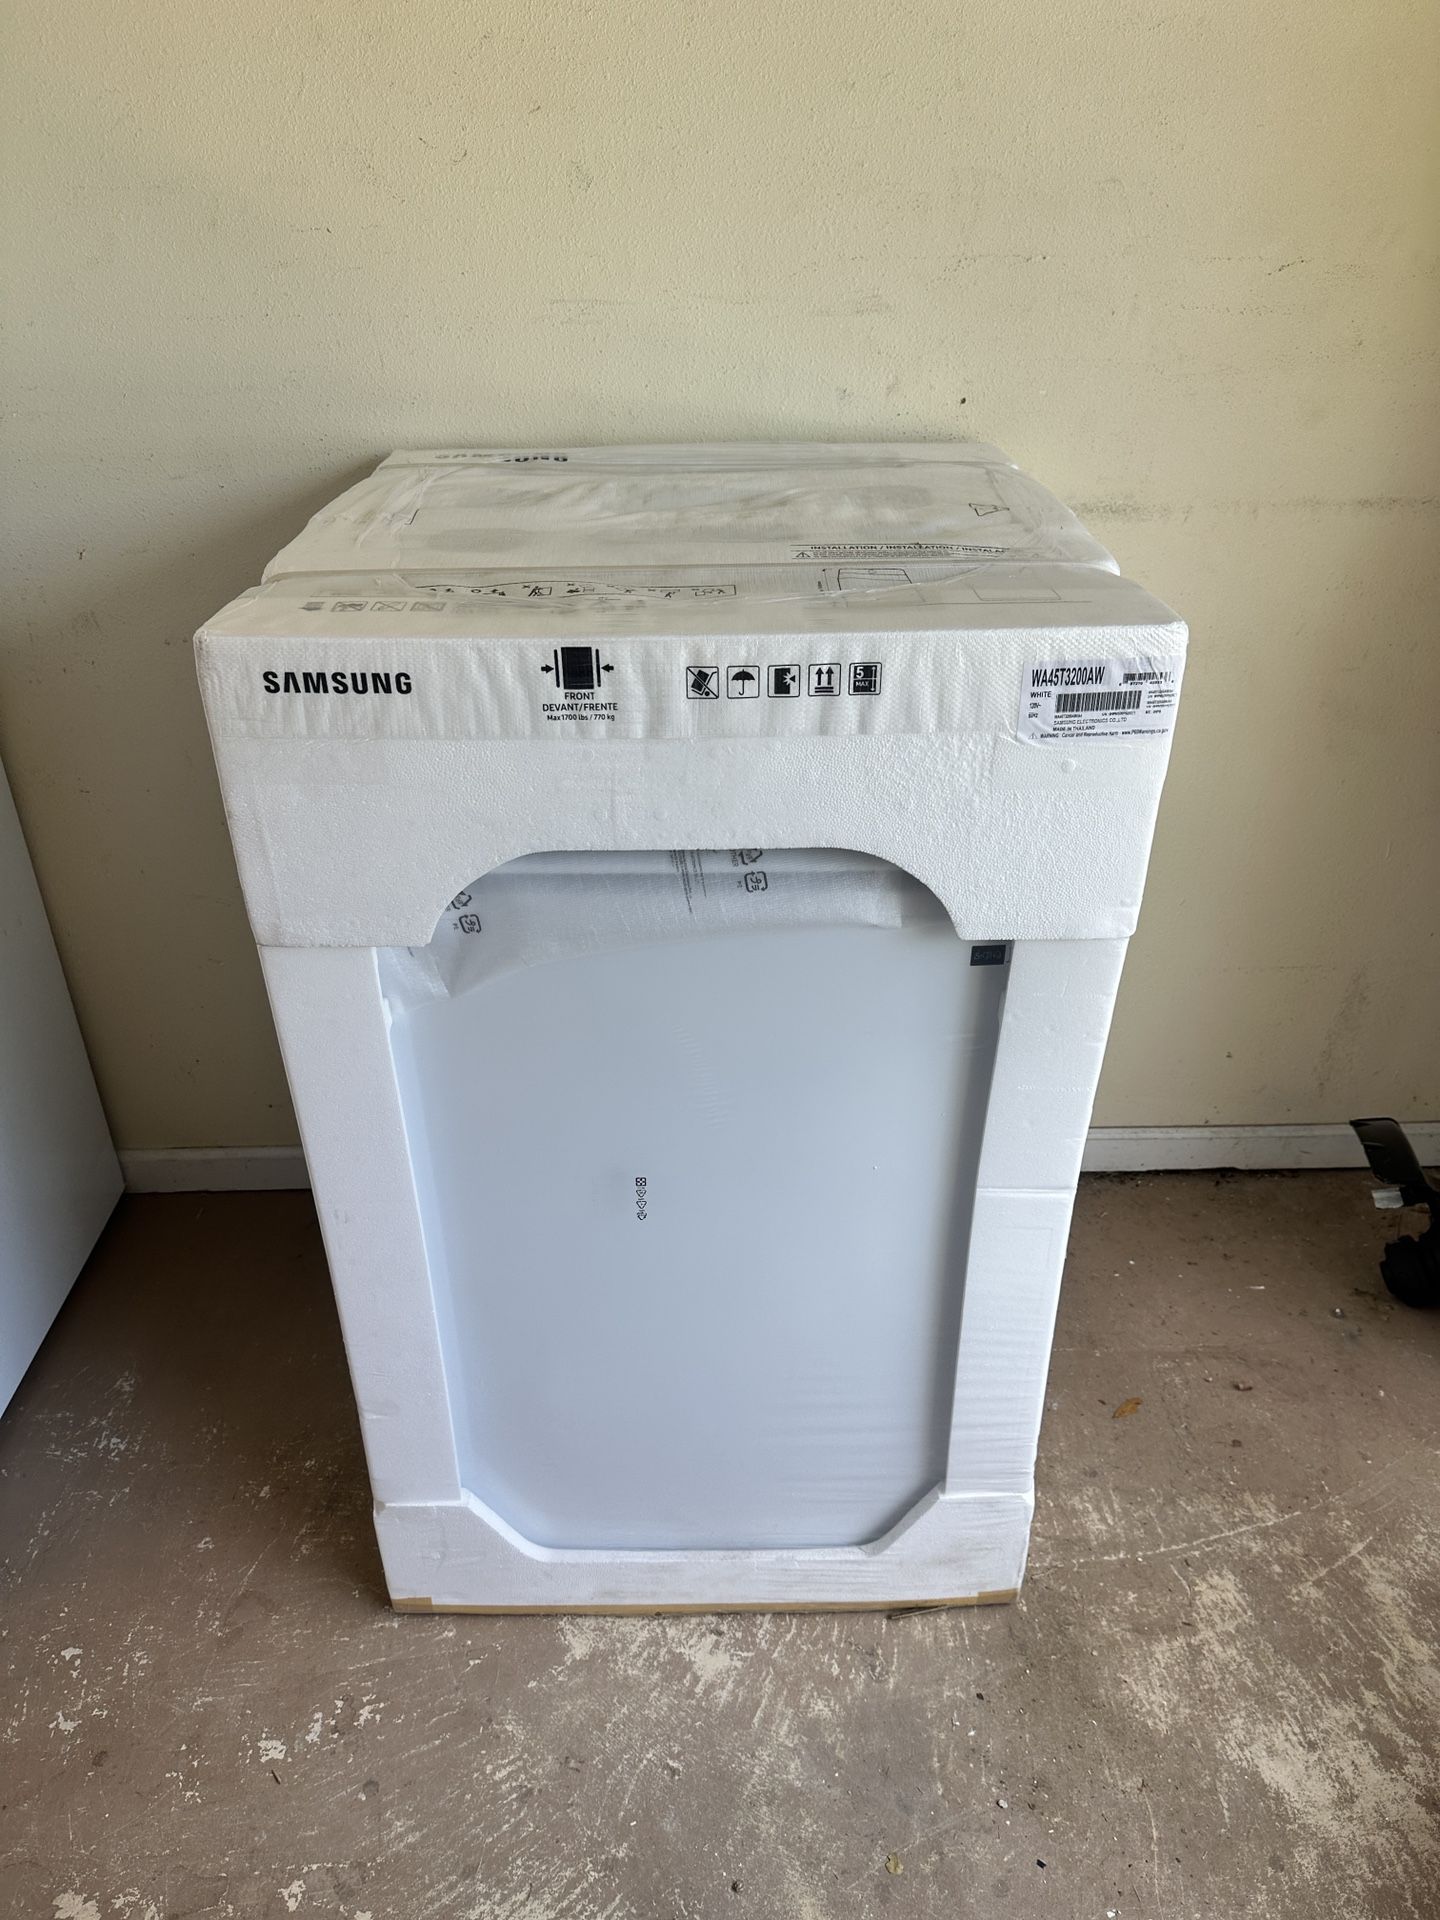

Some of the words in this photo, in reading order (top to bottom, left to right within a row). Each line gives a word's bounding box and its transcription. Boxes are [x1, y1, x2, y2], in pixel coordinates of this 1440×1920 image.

[856, 667, 864, 678] 5
[1031, 666, 1105, 687] WA45T3200AW
[262, 671, 413, 694] SAMSUNG
[564, 692, 595, 700] FRONT
[1030, 690, 1052, 698] WHITE
[542, 703, 618, 712] DEVANT/FRENTE
[607, 713, 615, 721] kg
